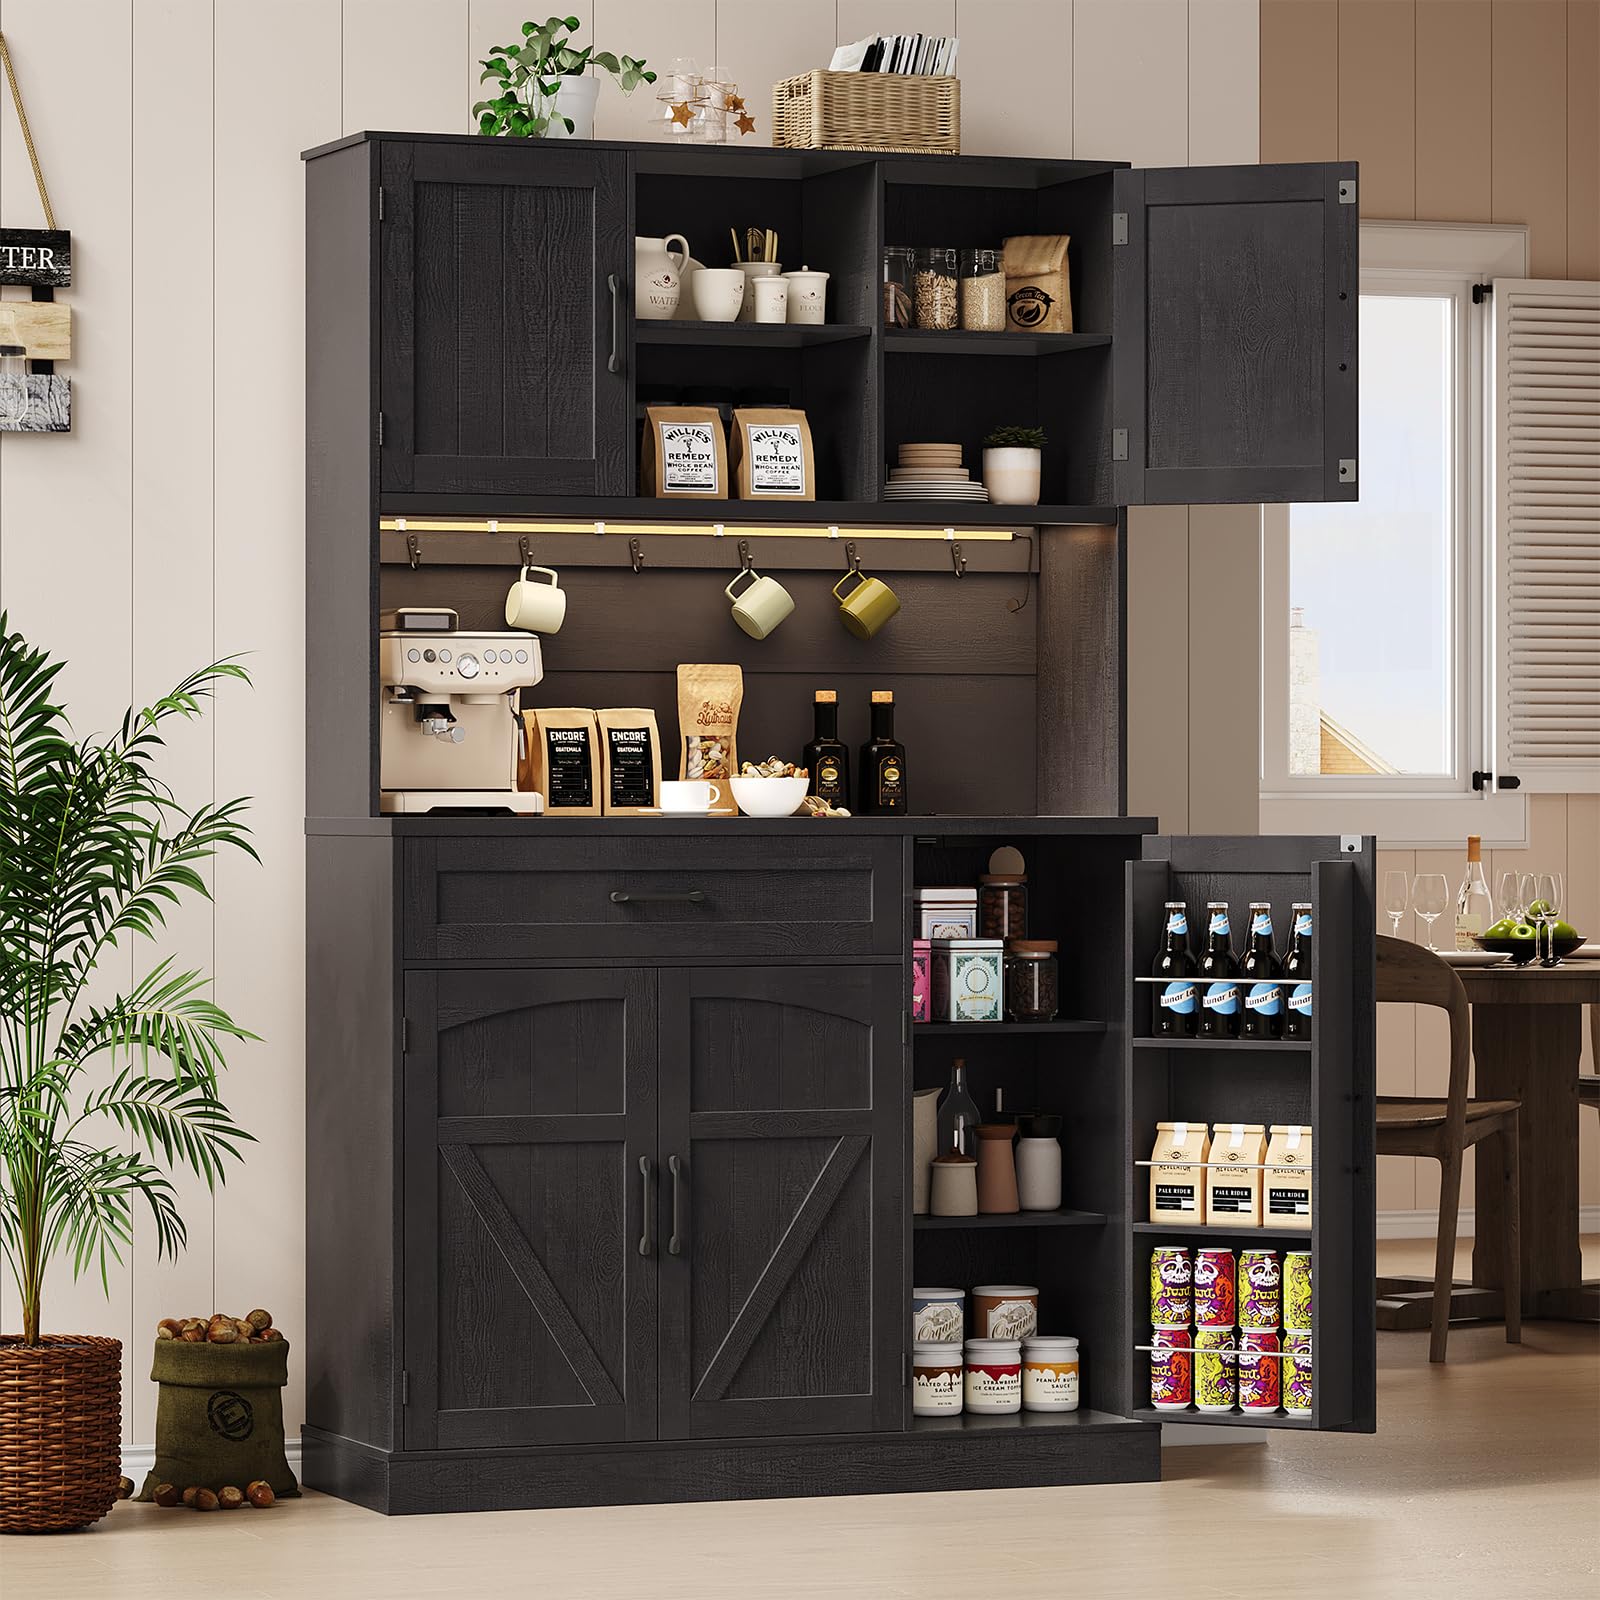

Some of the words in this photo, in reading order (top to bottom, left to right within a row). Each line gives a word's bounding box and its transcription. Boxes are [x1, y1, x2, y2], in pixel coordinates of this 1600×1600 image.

[0, 246, 56, 270] TER
[665, 428, 711, 443] WILLIE'S
[752, 430, 798, 445] WILLIE'S
[668, 452, 711, 461] REMEDY
[755, 454, 798, 463] REMEDY
[550, 731, 586, 742] ENCORE
[611, 731, 648, 742] ENCORE
[1161, 993, 1184, 1005] Lunar
[1203, 994, 1226, 1006] Lunar
[1246, 994, 1269, 1006] Lunar
[1163, 1286, 1190, 1298] JUJU
[1194, 1287, 1216, 1299] UJU
[1251, 1289, 1279, 1301] JUJU
[1151, 1365, 1172, 1377] UJU
[1239, 1368, 1261, 1380] UJU
